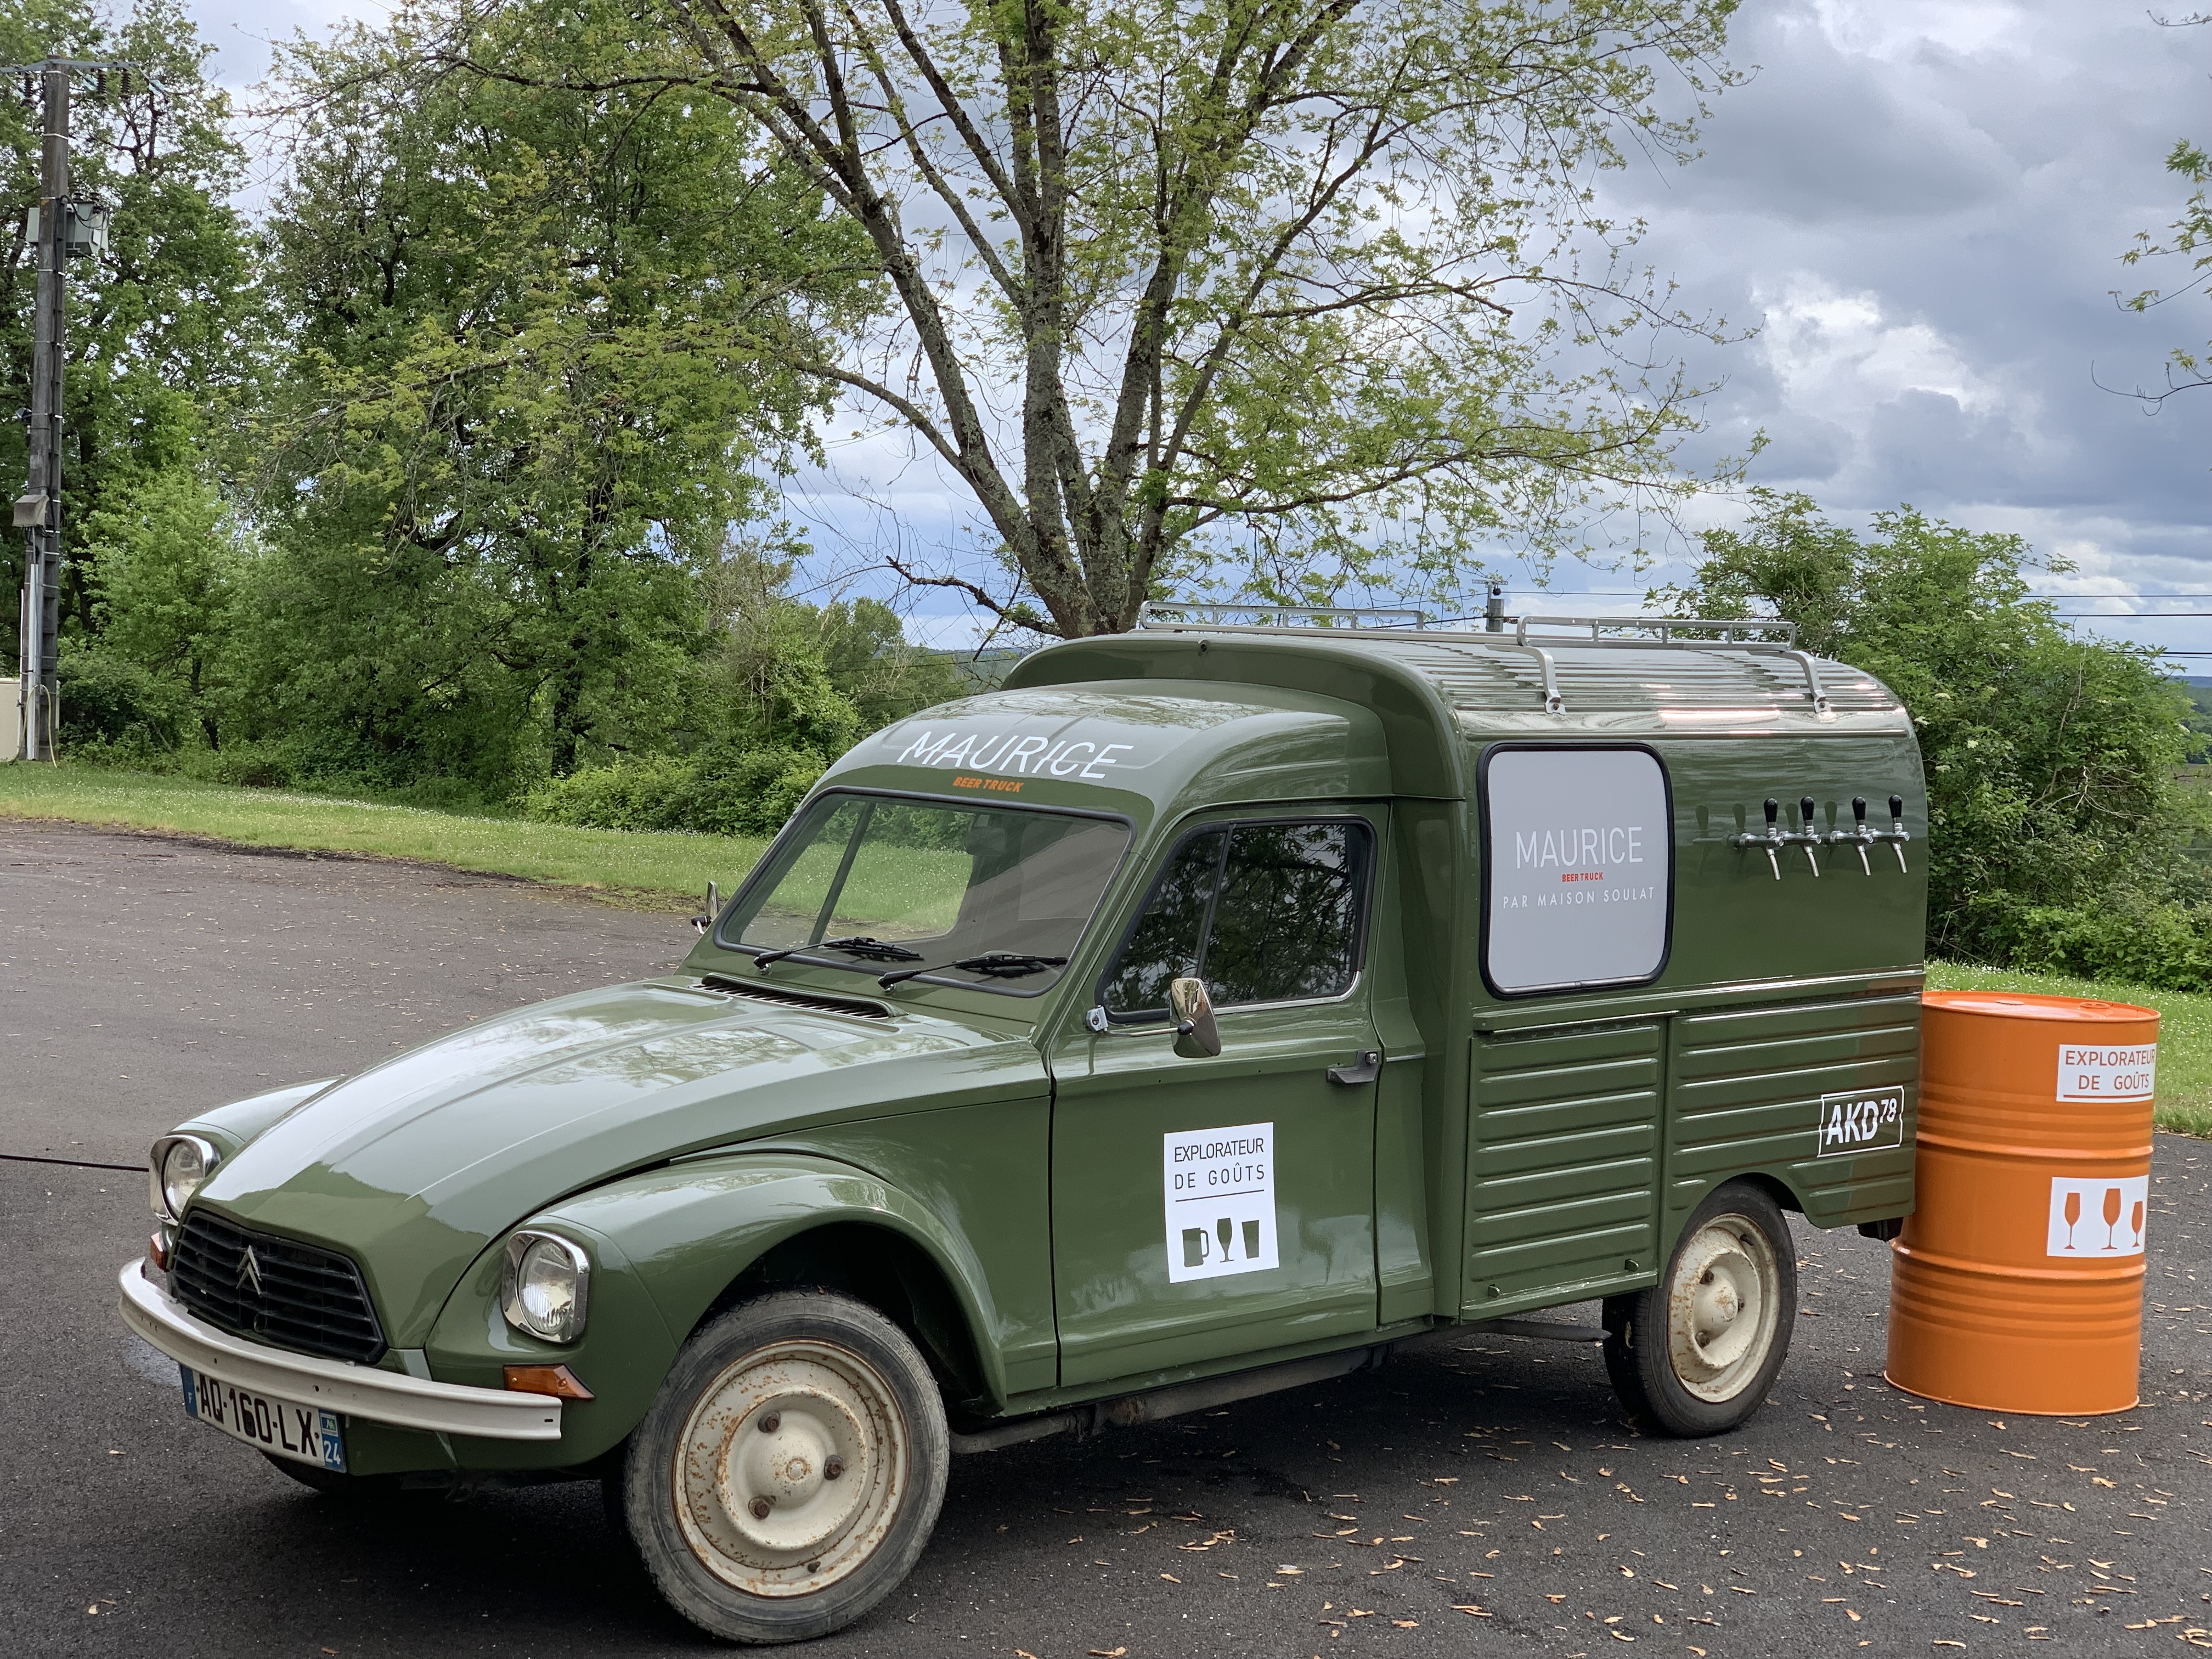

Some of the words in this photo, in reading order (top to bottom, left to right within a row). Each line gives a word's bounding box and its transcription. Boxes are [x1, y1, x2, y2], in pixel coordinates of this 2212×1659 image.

[896, 731, 1134, 779] MAURICE
[952, 776, 982, 789] BEER
[983, 778, 1024, 793] TRUCK
[1516, 826, 1644, 870] MAURICE
[1561, 873, 1579, 883] BEER
[1580, 872, 1604, 881] TRUCK
[1503, 895, 1528, 909] PAR
[1537, 890, 1595, 907] MAISON
[1604, 887, 1655, 902] SOULAT
[2065, 1049, 2155, 1066] EXPLORATEUR
[2078, 1075, 2101, 1090] DE
[2114, 1071, 2149, 1090] GOÛTS
[1175, 1137, 1264, 1163] EXPLORATEUR
[1175, 1172, 1196, 1190] DE
[1209, 1162, 1265, 1186] GOÛTS
[878, 1327, 927, 1387] MICHELIN
[188, 1392, 193, 1404] F
[324, 1440, 341, 1465] 24
